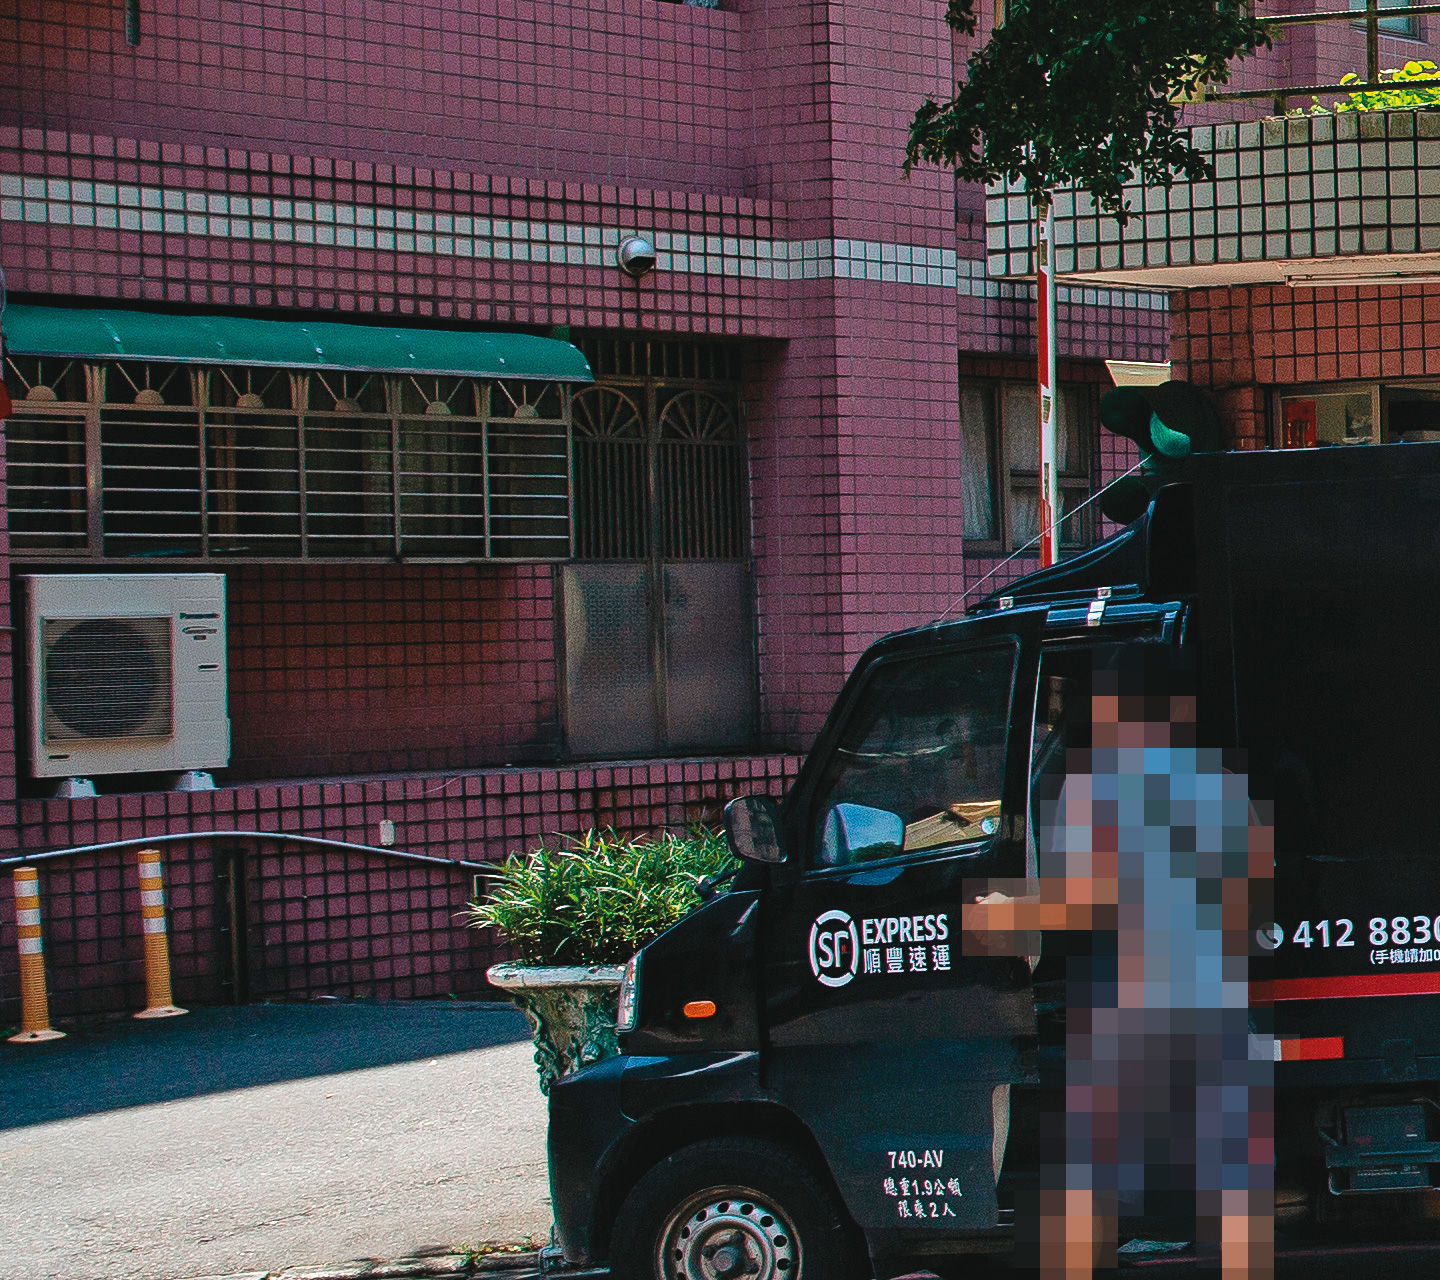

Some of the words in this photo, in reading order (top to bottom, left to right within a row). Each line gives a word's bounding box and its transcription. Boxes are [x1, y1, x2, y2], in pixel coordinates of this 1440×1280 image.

[862, 913, 949, 945] EXPRESS
[1293, 918, 1355, 948] 412
[863, 944, 951, 974] 順豐速運
[887, 1149, 944, 1168] 740-AV
